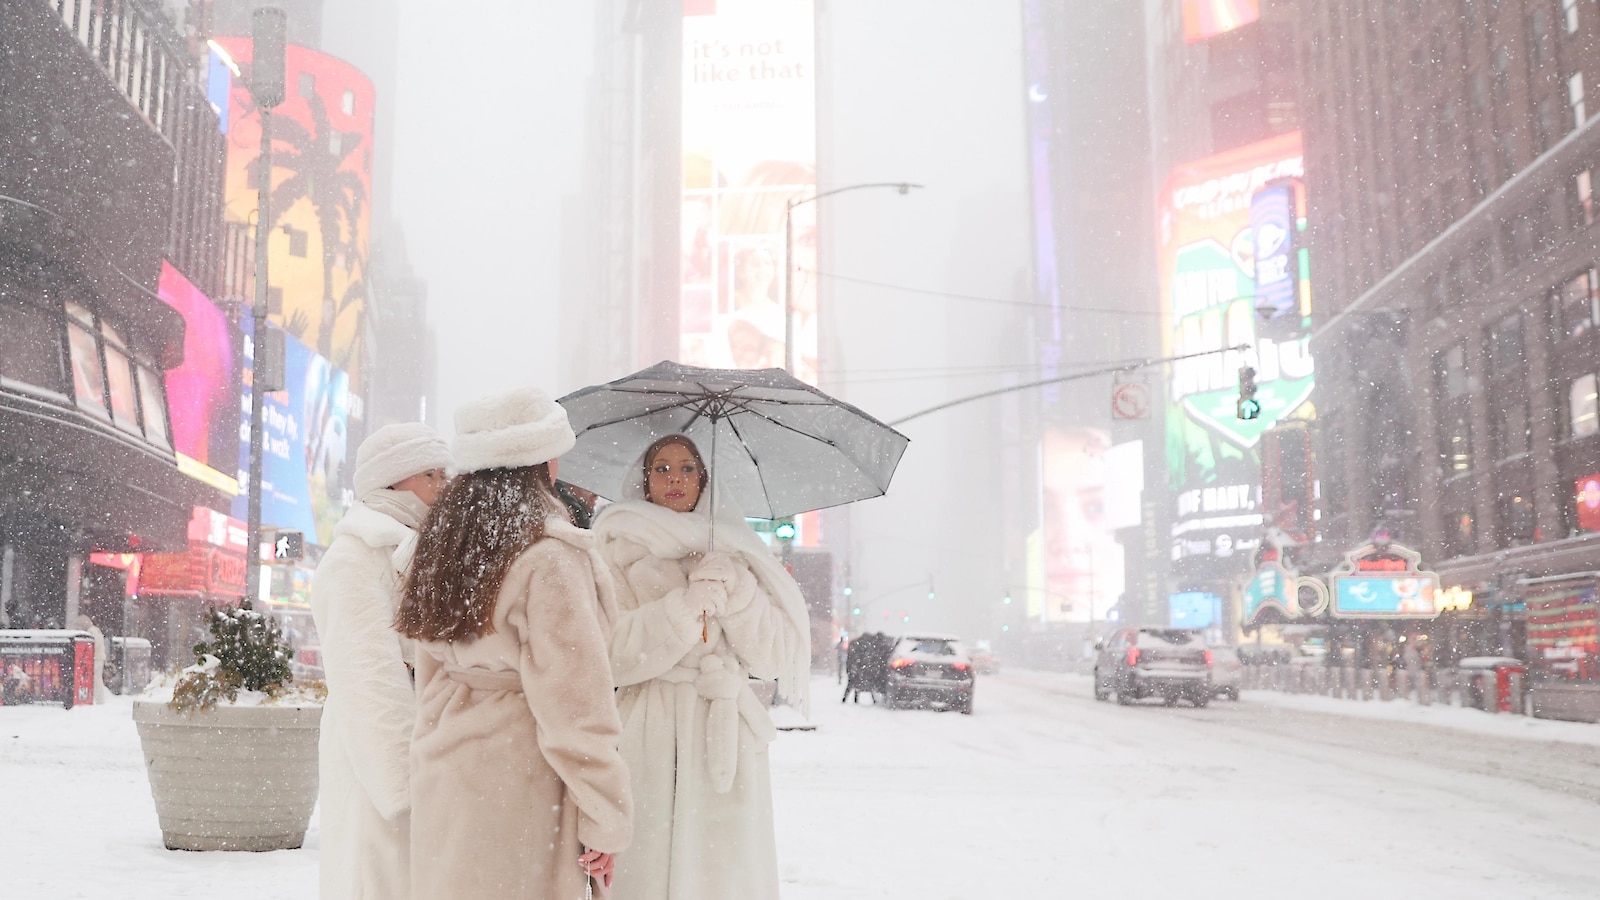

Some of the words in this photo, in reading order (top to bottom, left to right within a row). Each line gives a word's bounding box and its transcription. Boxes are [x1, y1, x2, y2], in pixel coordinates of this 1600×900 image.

[694, 39, 731, 59] it's
[740, 38, 783, 57] not
[694, 63, 740, 83] like
[749, 60, 804, 80] that
